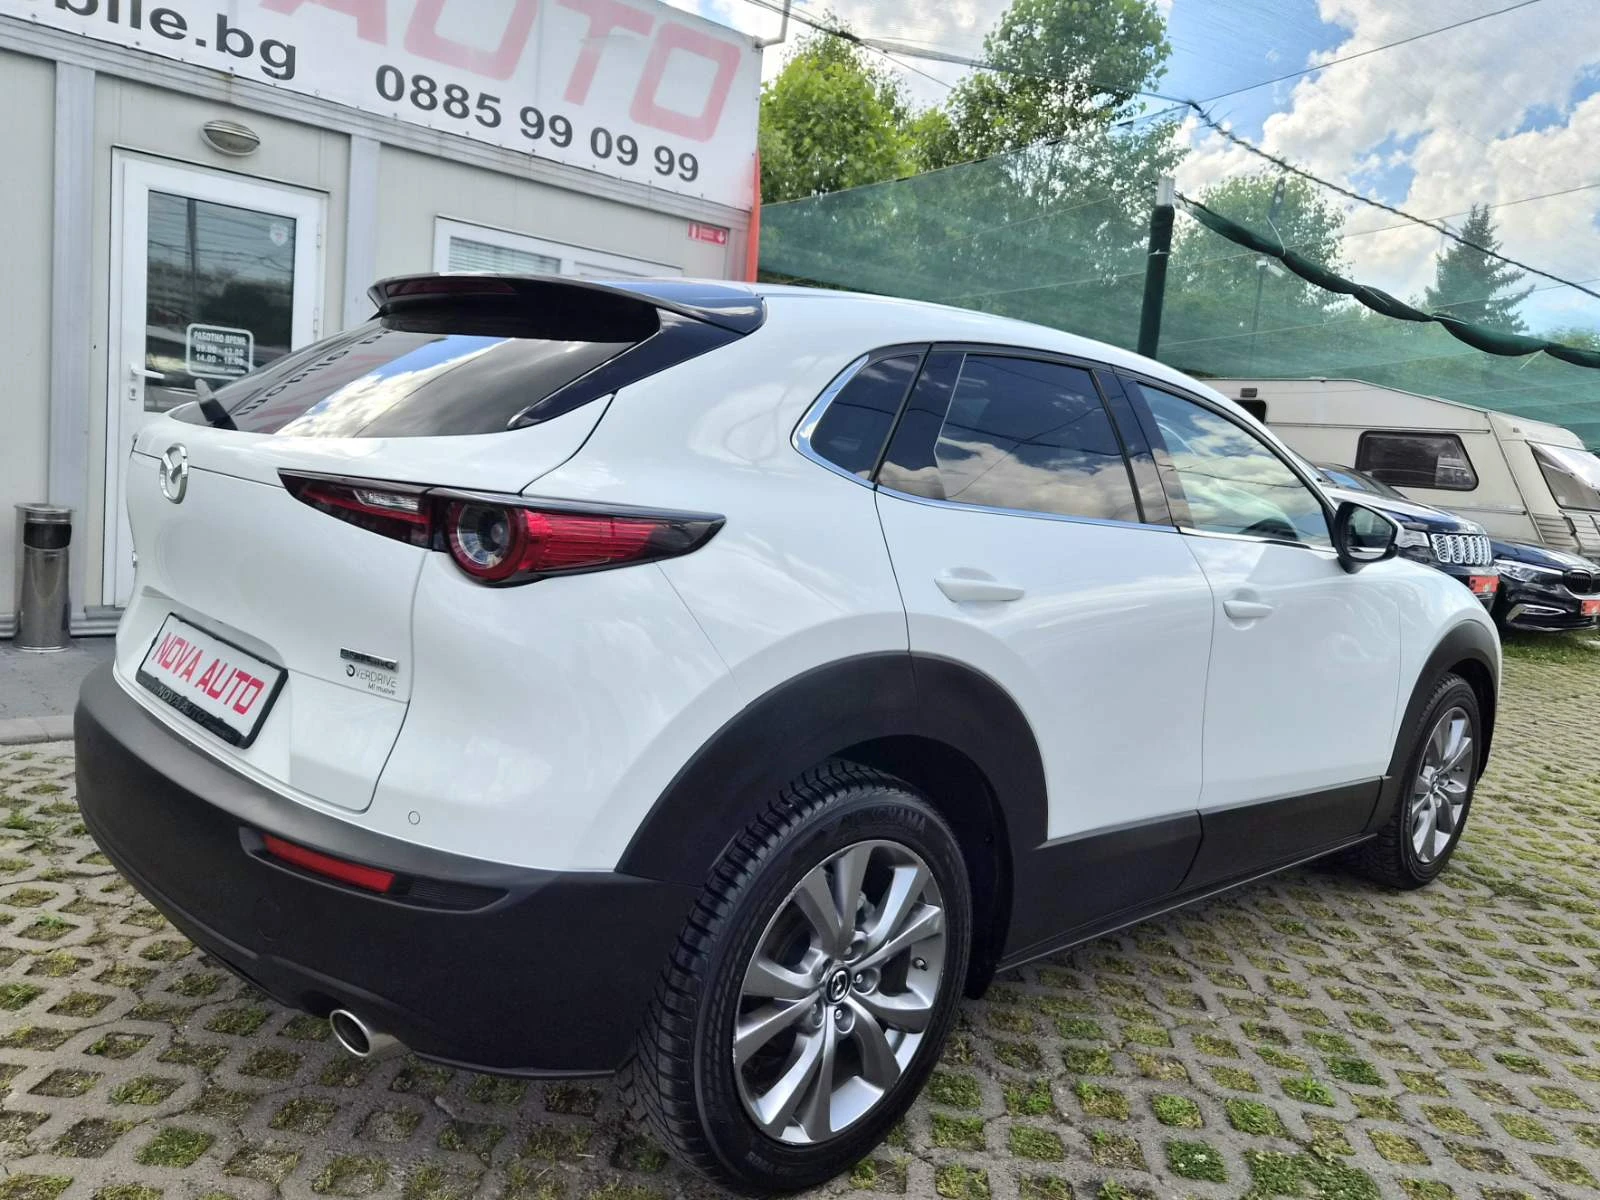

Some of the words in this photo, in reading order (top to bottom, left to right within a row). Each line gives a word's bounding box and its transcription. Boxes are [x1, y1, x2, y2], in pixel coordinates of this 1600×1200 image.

[375, 64, 502, 128] 0885
[520, 105, 573, 148] 99
[590, 127, 639, 166] 09
[653, 145, 699, 182] 99
[151, 631, 204, 682] NOVA
[194, 658, 265, 715] AUTO
